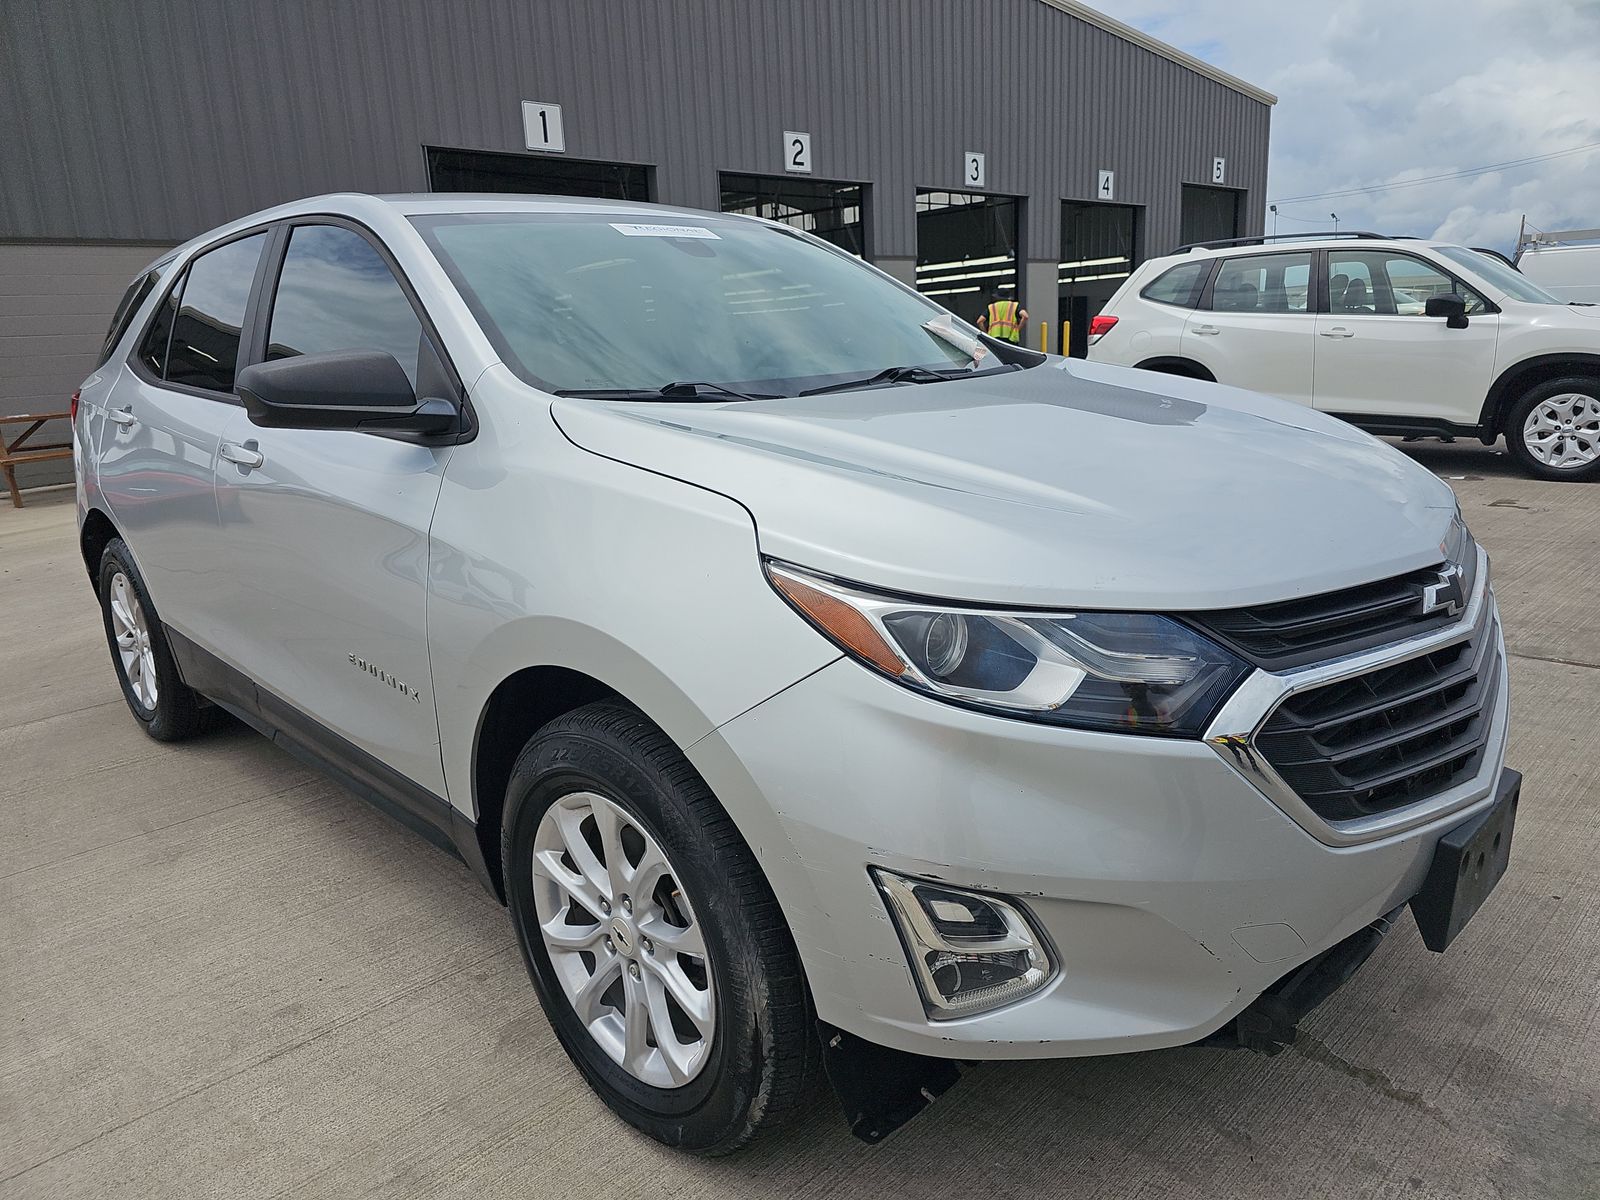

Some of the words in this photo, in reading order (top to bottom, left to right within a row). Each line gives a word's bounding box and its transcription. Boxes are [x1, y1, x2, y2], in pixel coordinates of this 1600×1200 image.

[538, 110, 549, 144] 1
[791, 138, 805, 167] 2
[970, 158, 980, 182] 3
[1102, 176, 1110, 196] 4
[348, 652, 421, 704] EQUINOX
